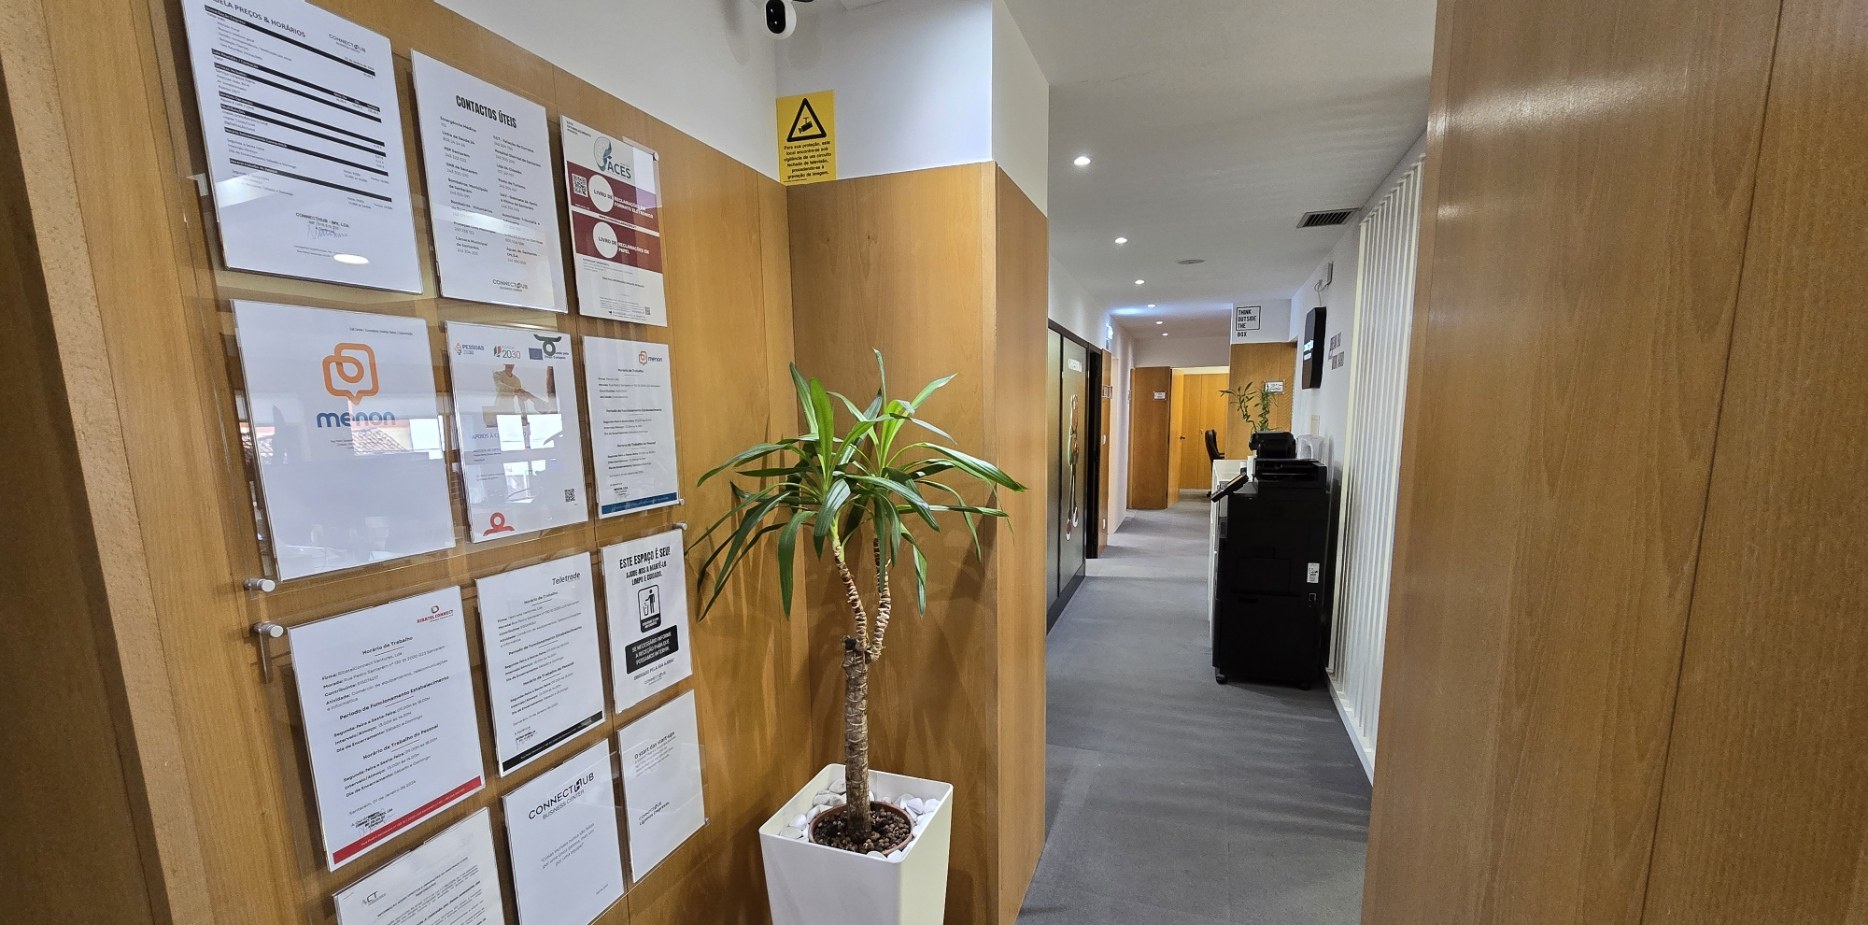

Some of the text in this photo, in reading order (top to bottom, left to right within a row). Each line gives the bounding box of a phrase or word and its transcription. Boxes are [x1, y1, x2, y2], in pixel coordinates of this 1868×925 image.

[235, 5, 262, 20] PREÇOS
[271, 17, 306, 37] HORÁRIOS
[456, 95, 517, 129] CONTACTOS ÚTEIS
[607, 161, 631, 179] ACES
[503, 350, 520, 358] 2030
[317, 411, 396, 427] menon
[620, 557, 632, 569] ESTE
[634, 551, 654, 568] ESPAÇO
[660, 547, 670, 558] SEU!
[552, 571, 581, 586] Teletrade
[362, 645, 383, 655] Horário
[391, 636, 414, 646] Trabalho
[529, 773, 594, 820] CONNECTHUB
[543, 790, 584, 819] BUSINESS CENTER
